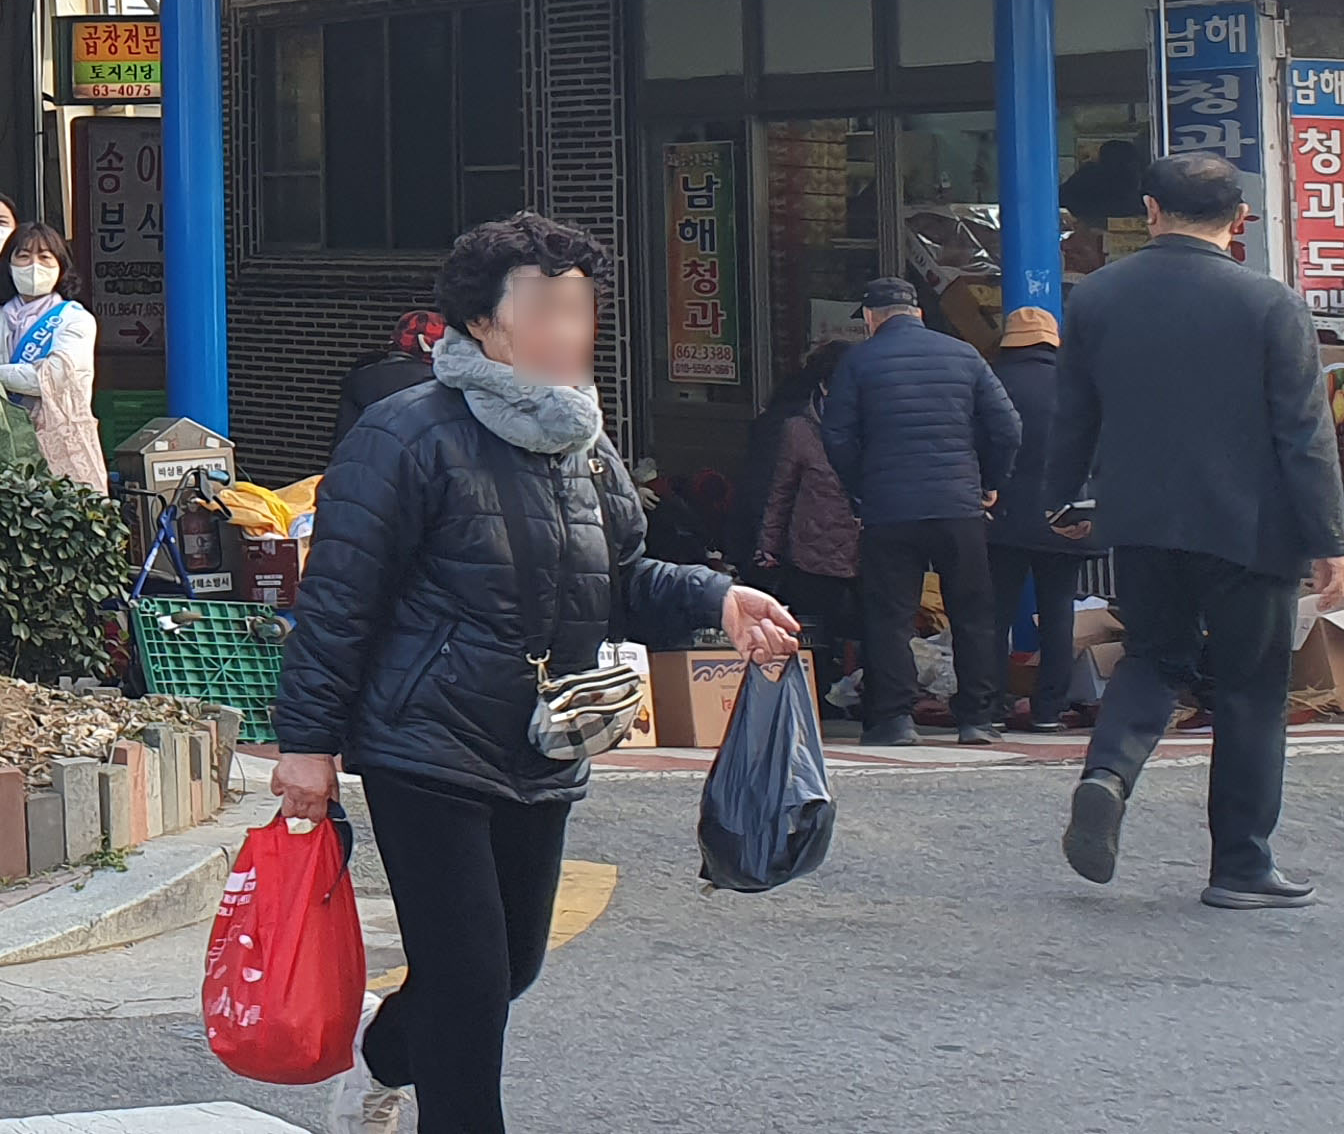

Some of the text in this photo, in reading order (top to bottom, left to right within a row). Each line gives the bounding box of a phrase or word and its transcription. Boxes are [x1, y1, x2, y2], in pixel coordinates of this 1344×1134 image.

[81, 23, 160, 56] 곱창전문
[1164, 13, 1248, 59] 남해
[89, 63, 154, 81] 토지식당
[92, 84, 152, 97] 63-4075
[677, 174, 727, 336] 남해청과
